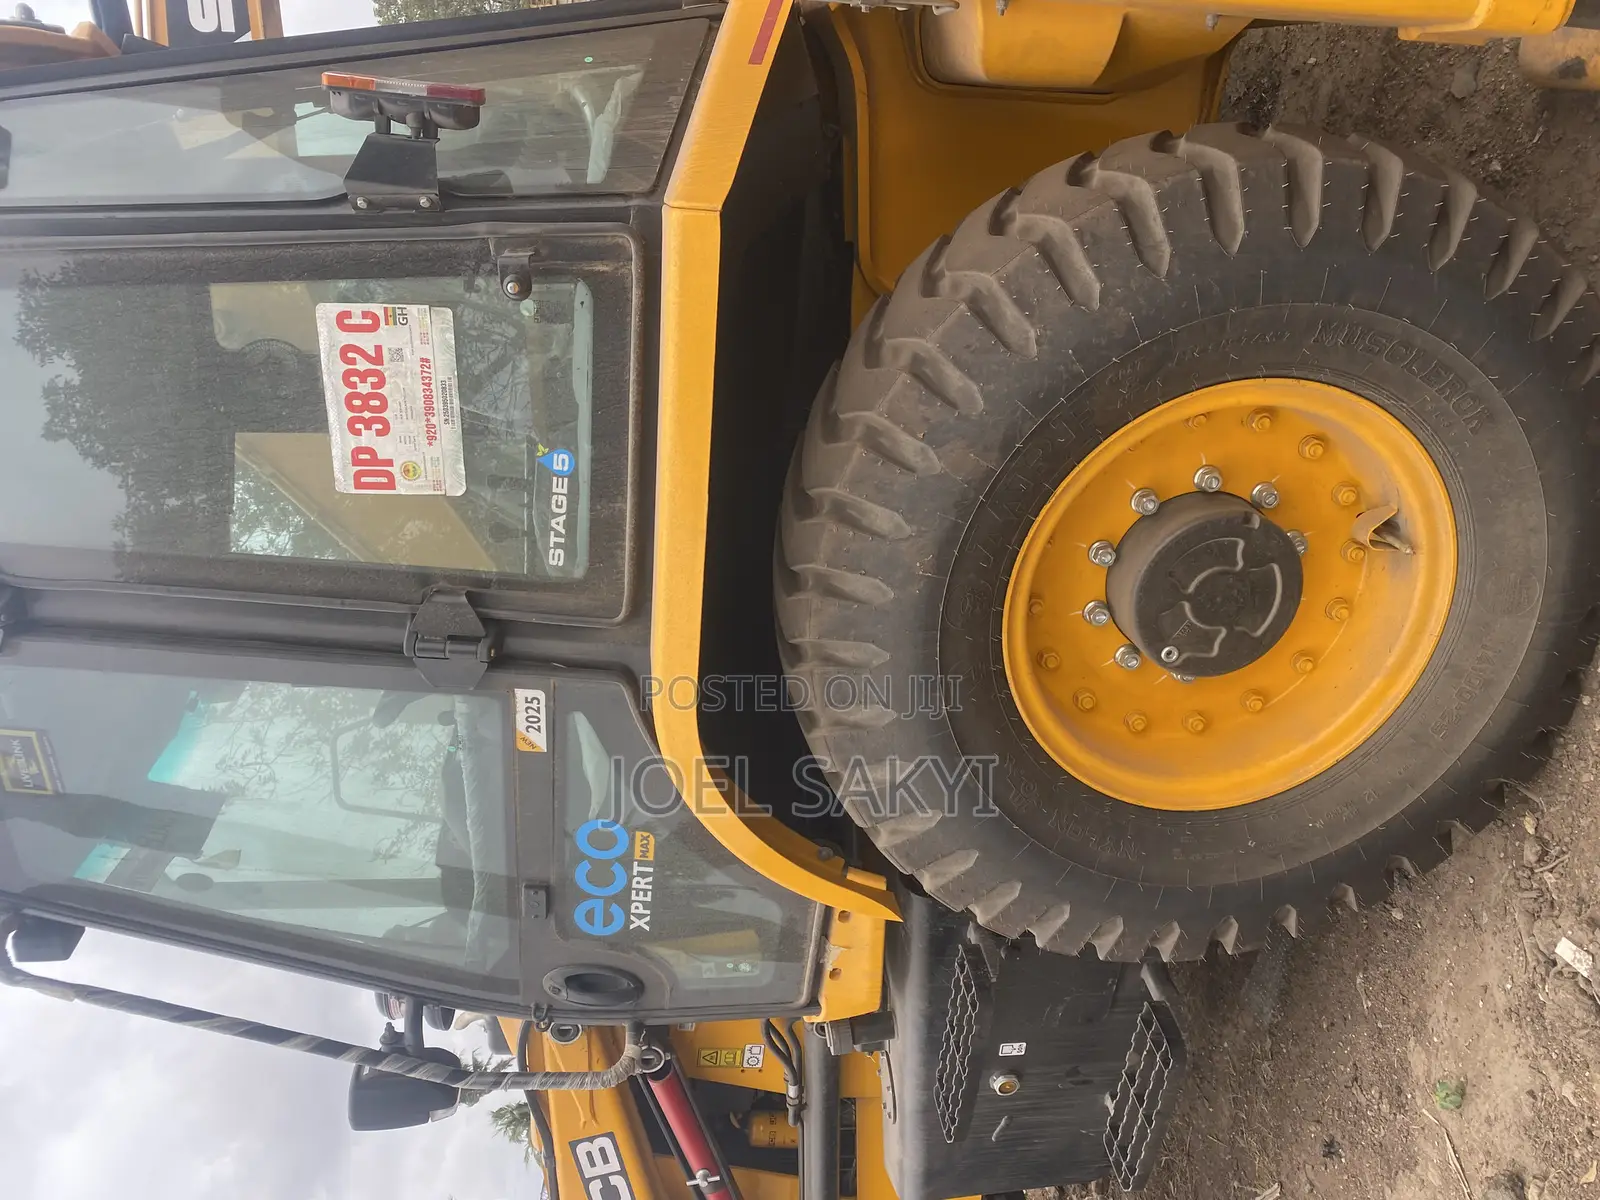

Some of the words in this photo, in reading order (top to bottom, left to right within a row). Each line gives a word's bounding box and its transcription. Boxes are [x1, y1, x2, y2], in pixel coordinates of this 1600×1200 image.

[336, 310, 380, 333] C
[396, 306, 408, 326] GH
[339, 343, 390, 437] 3832
[351, 446, 396, 490] DP
[554, 454, 569, 472] 5
[548, 477, 568, 566] STAGE
[524, 696, 542, 734] 2025
[520, 736, 537, 750] NEW
[640, 833, 650, 859] MAX
[574, 819, 630, 936] eco
[629, 861, 654, 932] XPERT
